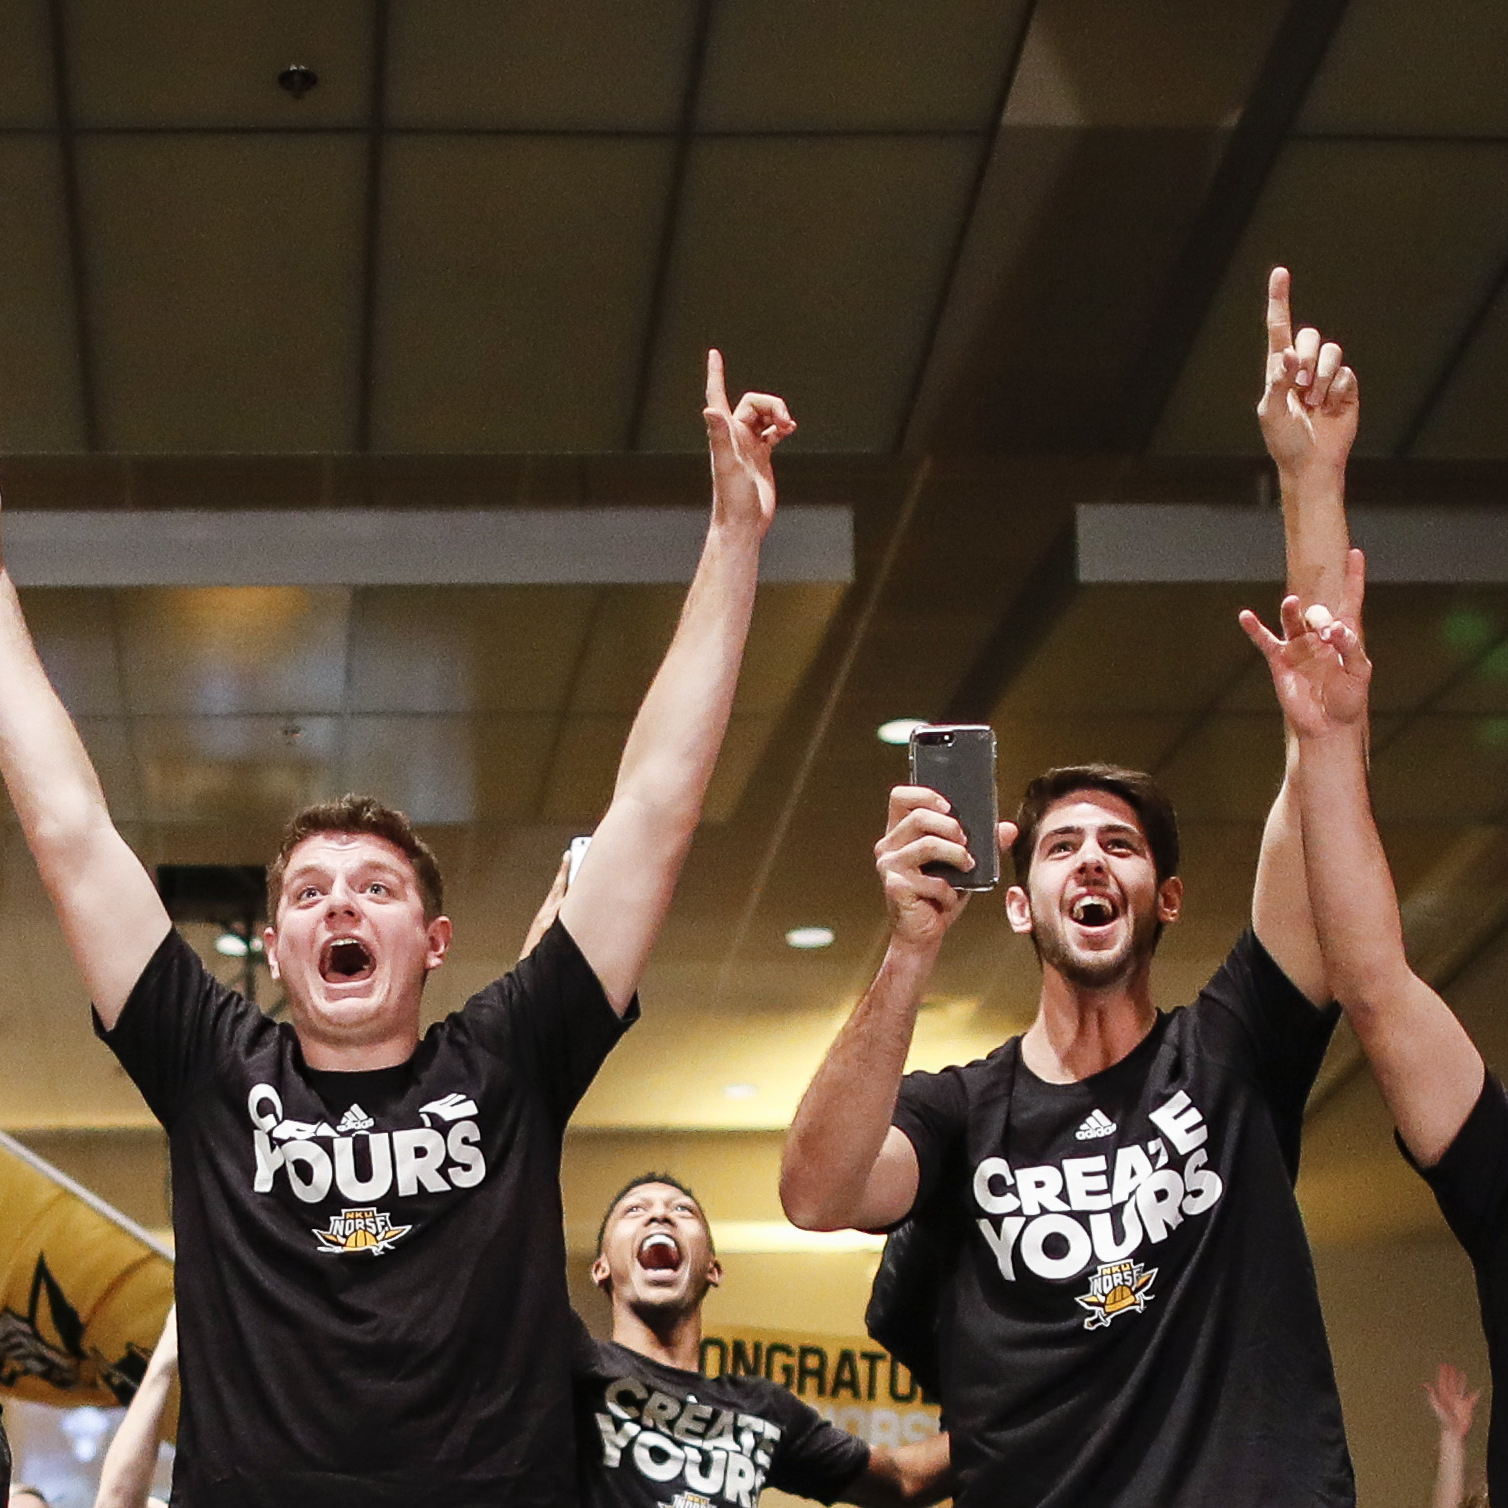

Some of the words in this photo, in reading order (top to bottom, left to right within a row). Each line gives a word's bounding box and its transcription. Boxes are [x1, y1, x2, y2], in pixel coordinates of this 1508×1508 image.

[253, 1120, 486, 1203] YOURS
[333, 1218, 388, 1235] NORSE
[975, 1148, 1223, 1281] YOURS
[1102, 1263, 1131, 1275] NKU
[699, 1337, 941, 1405] ONGRATU
